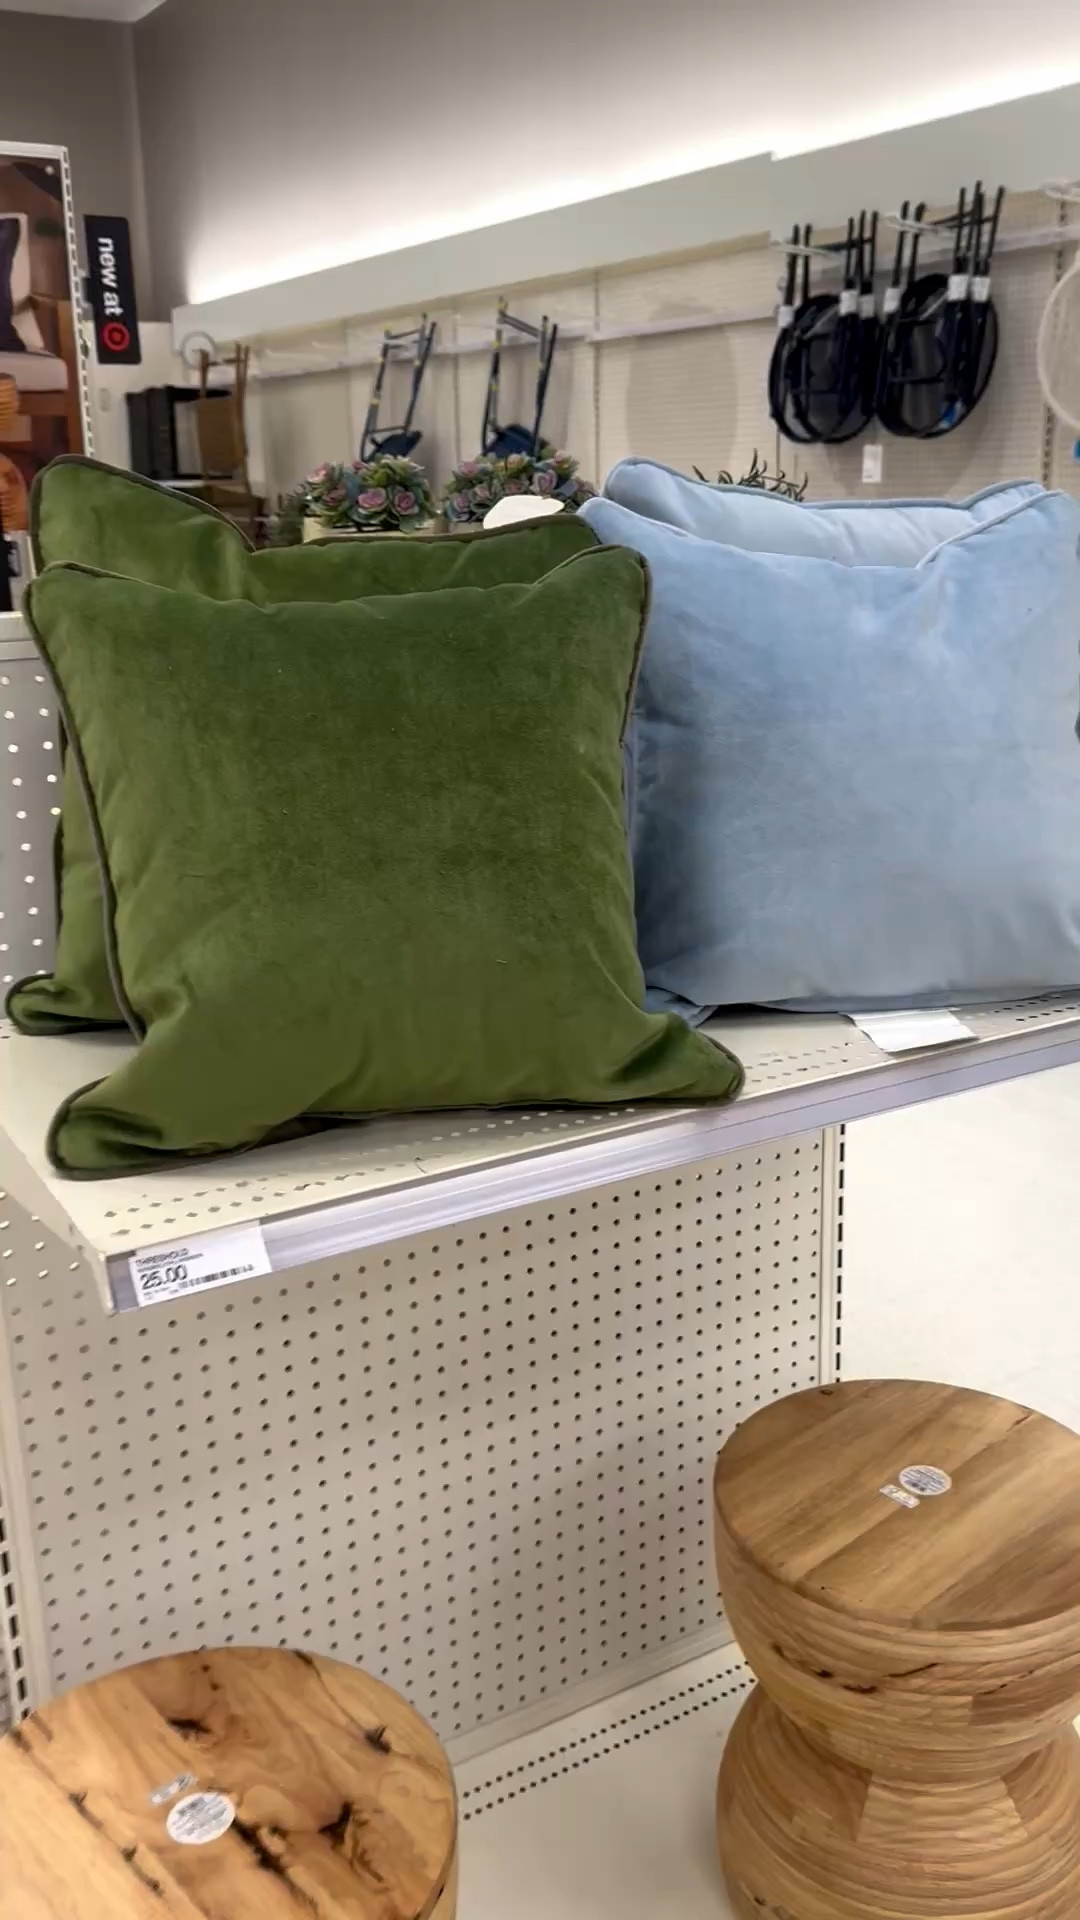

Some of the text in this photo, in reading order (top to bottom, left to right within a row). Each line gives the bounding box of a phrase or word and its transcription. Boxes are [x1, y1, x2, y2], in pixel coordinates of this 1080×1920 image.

[98, 237, 123, 316] new at
[140, 1264, 187, 1289] 25.00
